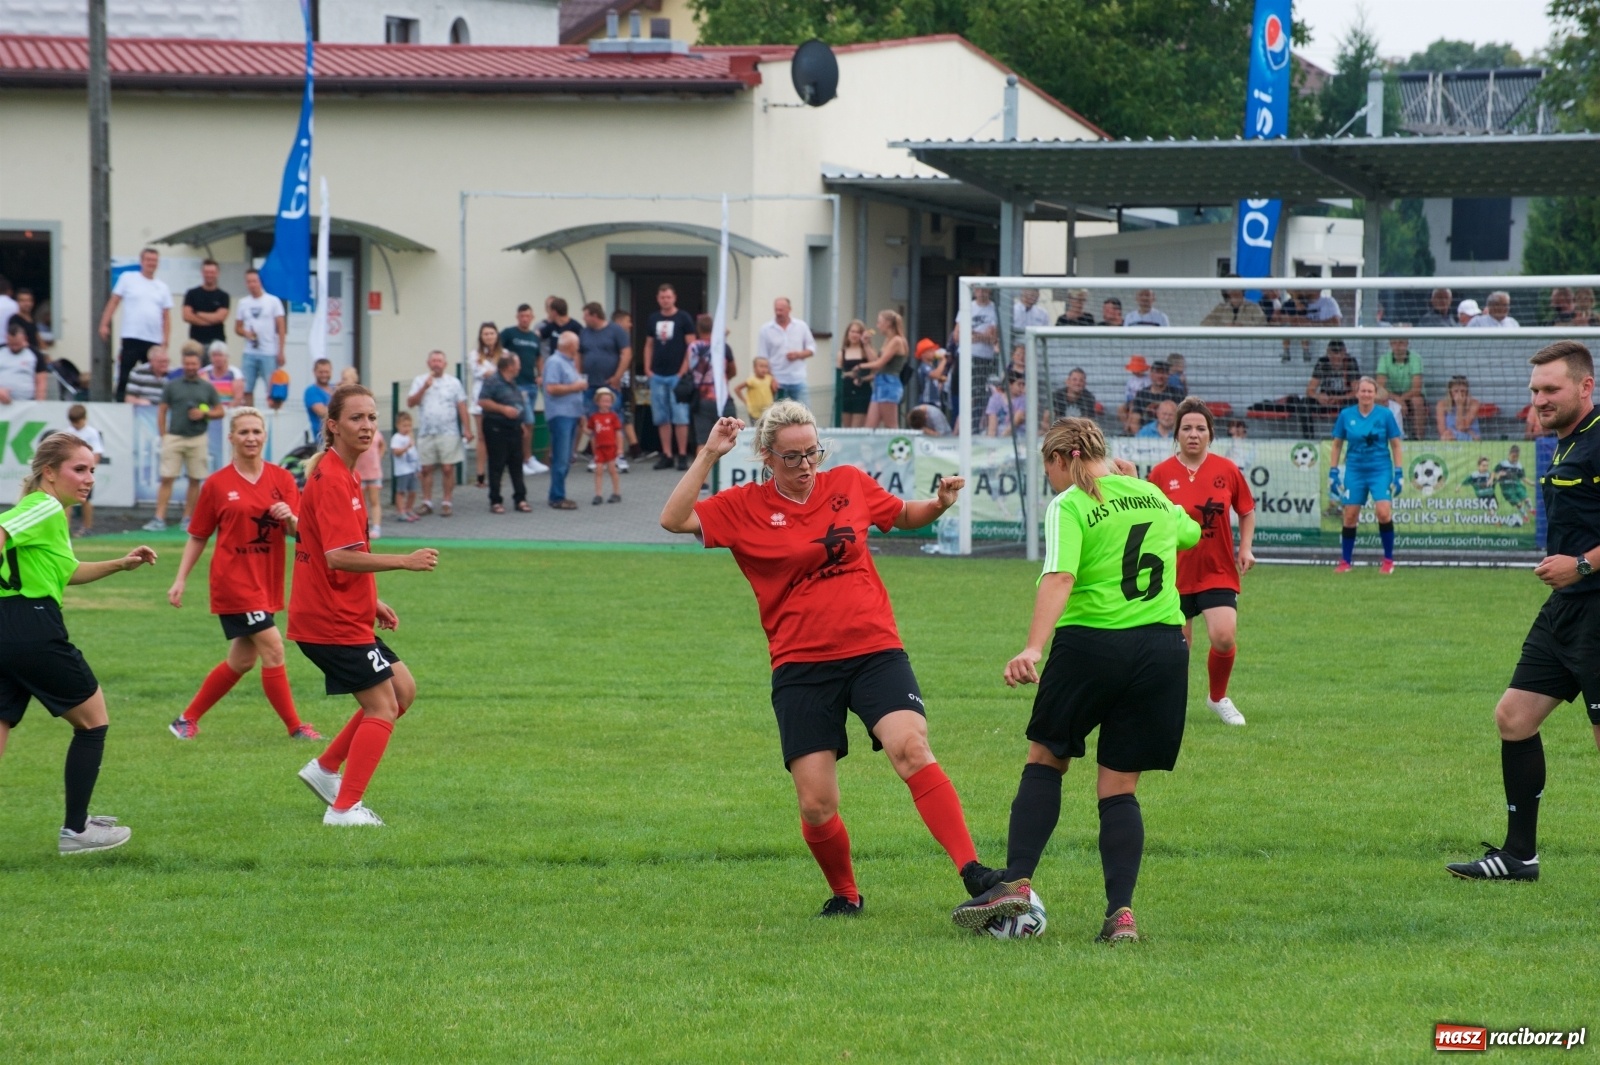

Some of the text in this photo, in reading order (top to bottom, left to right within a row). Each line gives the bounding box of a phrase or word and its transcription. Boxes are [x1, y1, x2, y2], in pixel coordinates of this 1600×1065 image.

[1087, 493, 1170, 528] LKS TWORKÓW
[1427, 497, 1498, 510] PIŁKARSKA
[1120, 521, 1165, 602] 6
[246, 610, 266, 626] 15
